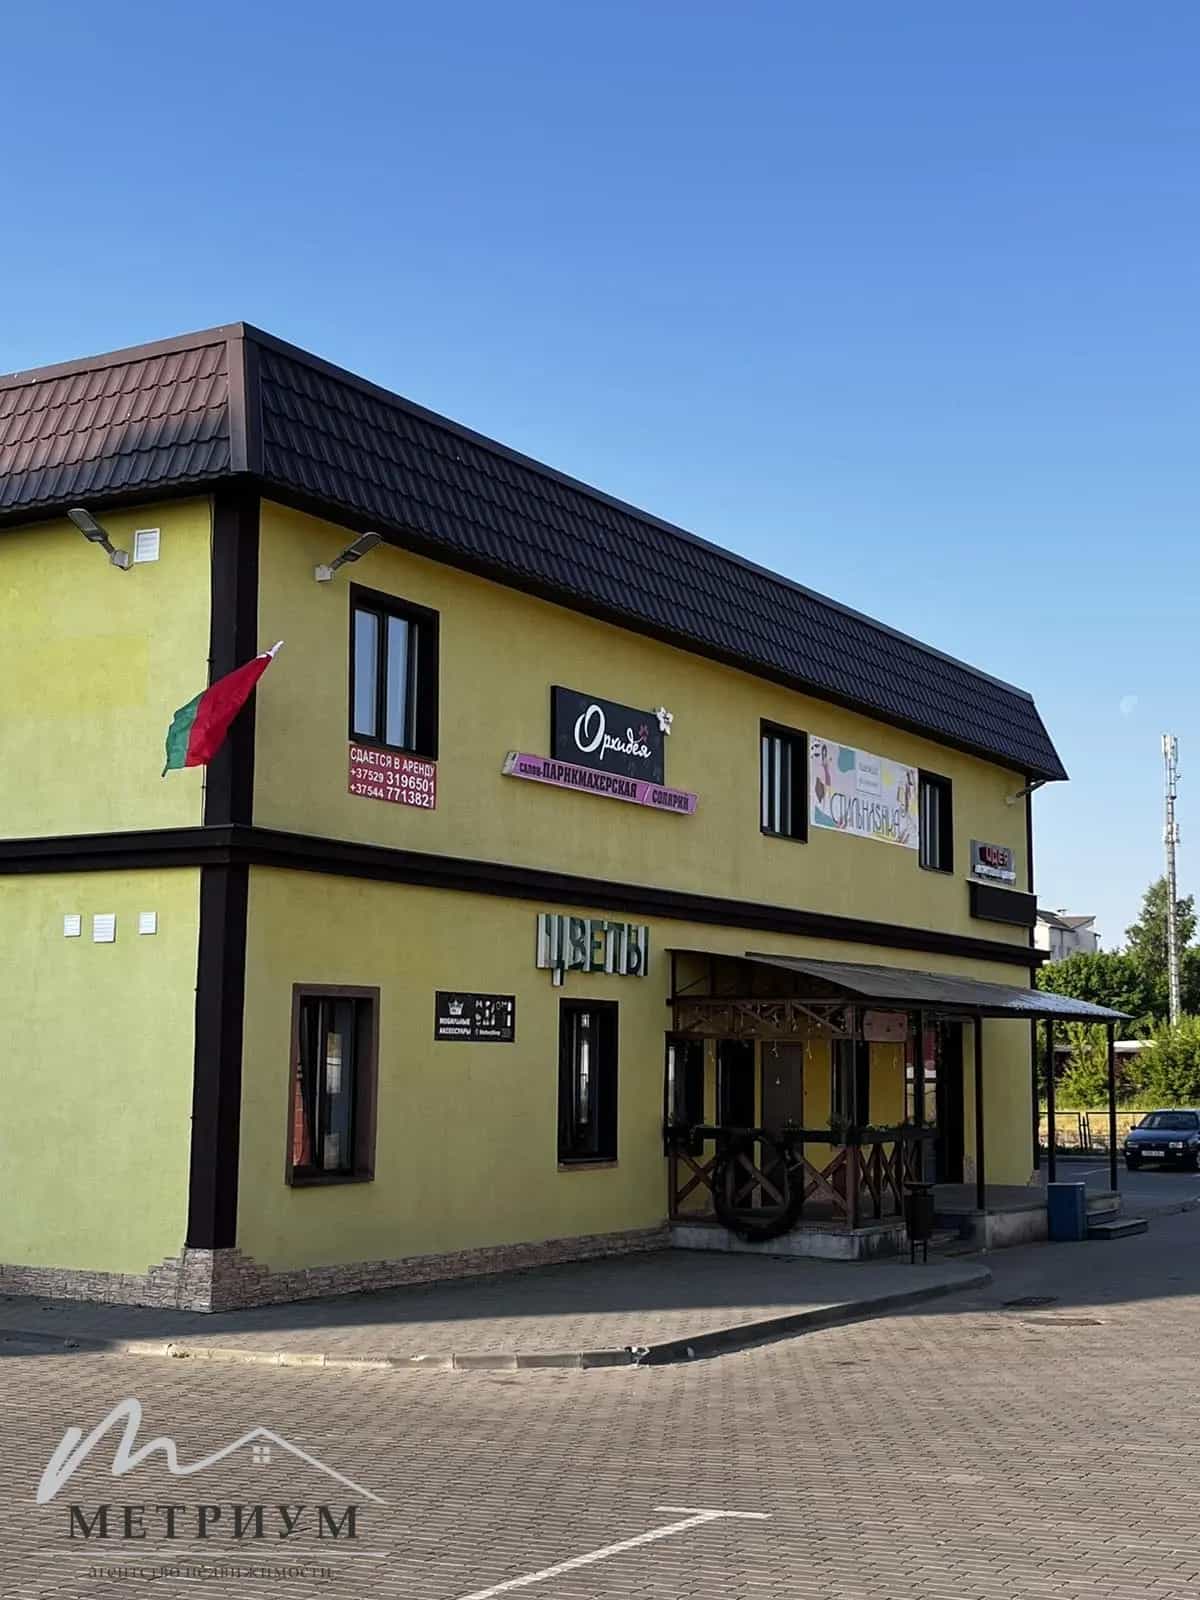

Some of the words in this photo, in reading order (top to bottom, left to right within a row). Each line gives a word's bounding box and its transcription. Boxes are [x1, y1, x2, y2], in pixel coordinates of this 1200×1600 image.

[574, 704, 651, 760] Орхидея
[350, 747, 392, 768] СДАЕТСЯ
[394, 757, 400, 770] В
[402, 759, 435, 777] АРЕНДУ
[350, 768, 384, 783] +37529
[386, 771, 434, 794] 3196501
[350, 783, 384, 798] +37544
[386, 786, 434, 809] 7713821
[537, 913, 648, 986] ЦВЕТЫ
